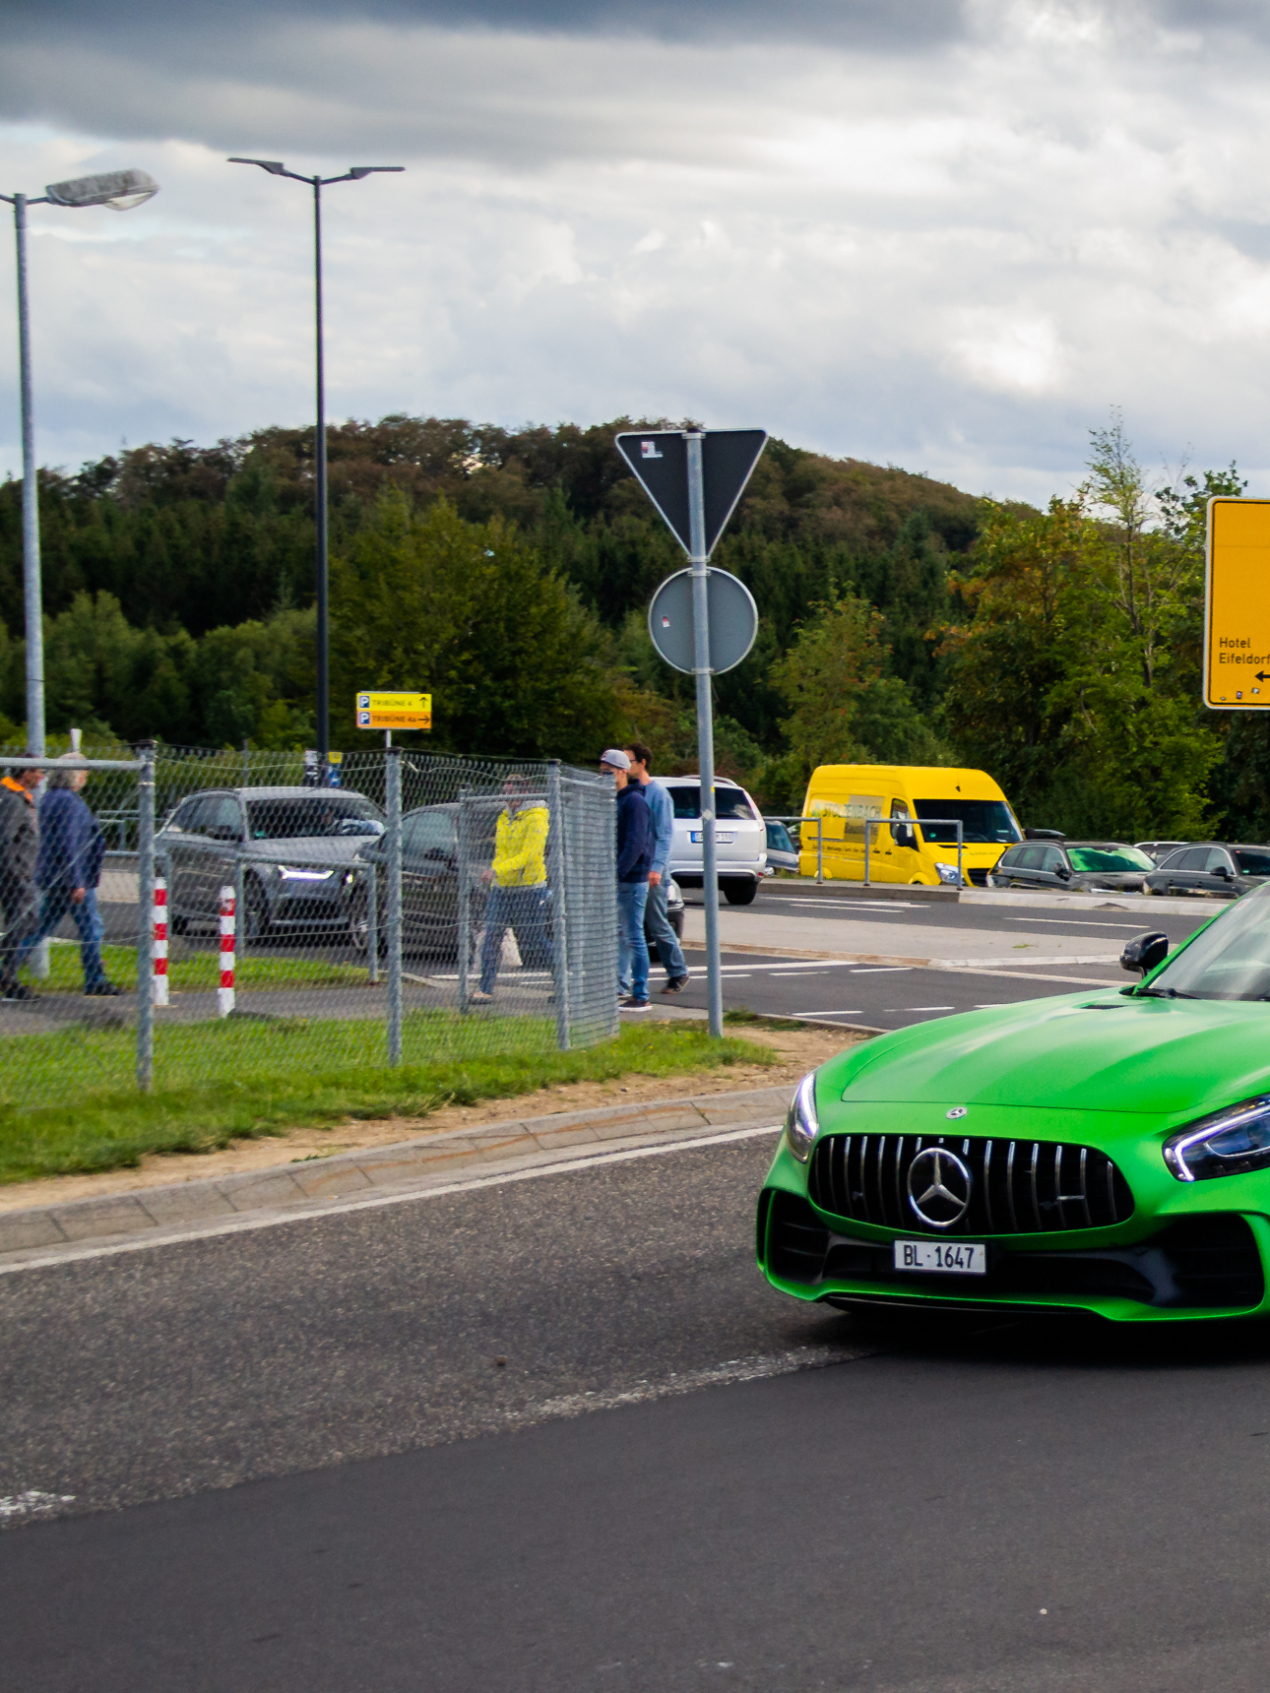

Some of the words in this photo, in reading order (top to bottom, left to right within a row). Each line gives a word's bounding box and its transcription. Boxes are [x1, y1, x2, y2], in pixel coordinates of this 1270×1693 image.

[1219, 637, 1251, 649] Hotel
[1219, 652, 1270, 665] Eifeldorf
[903, 1244, 924, 1267] BL
[934, 1245, 975, 1269] 1647
